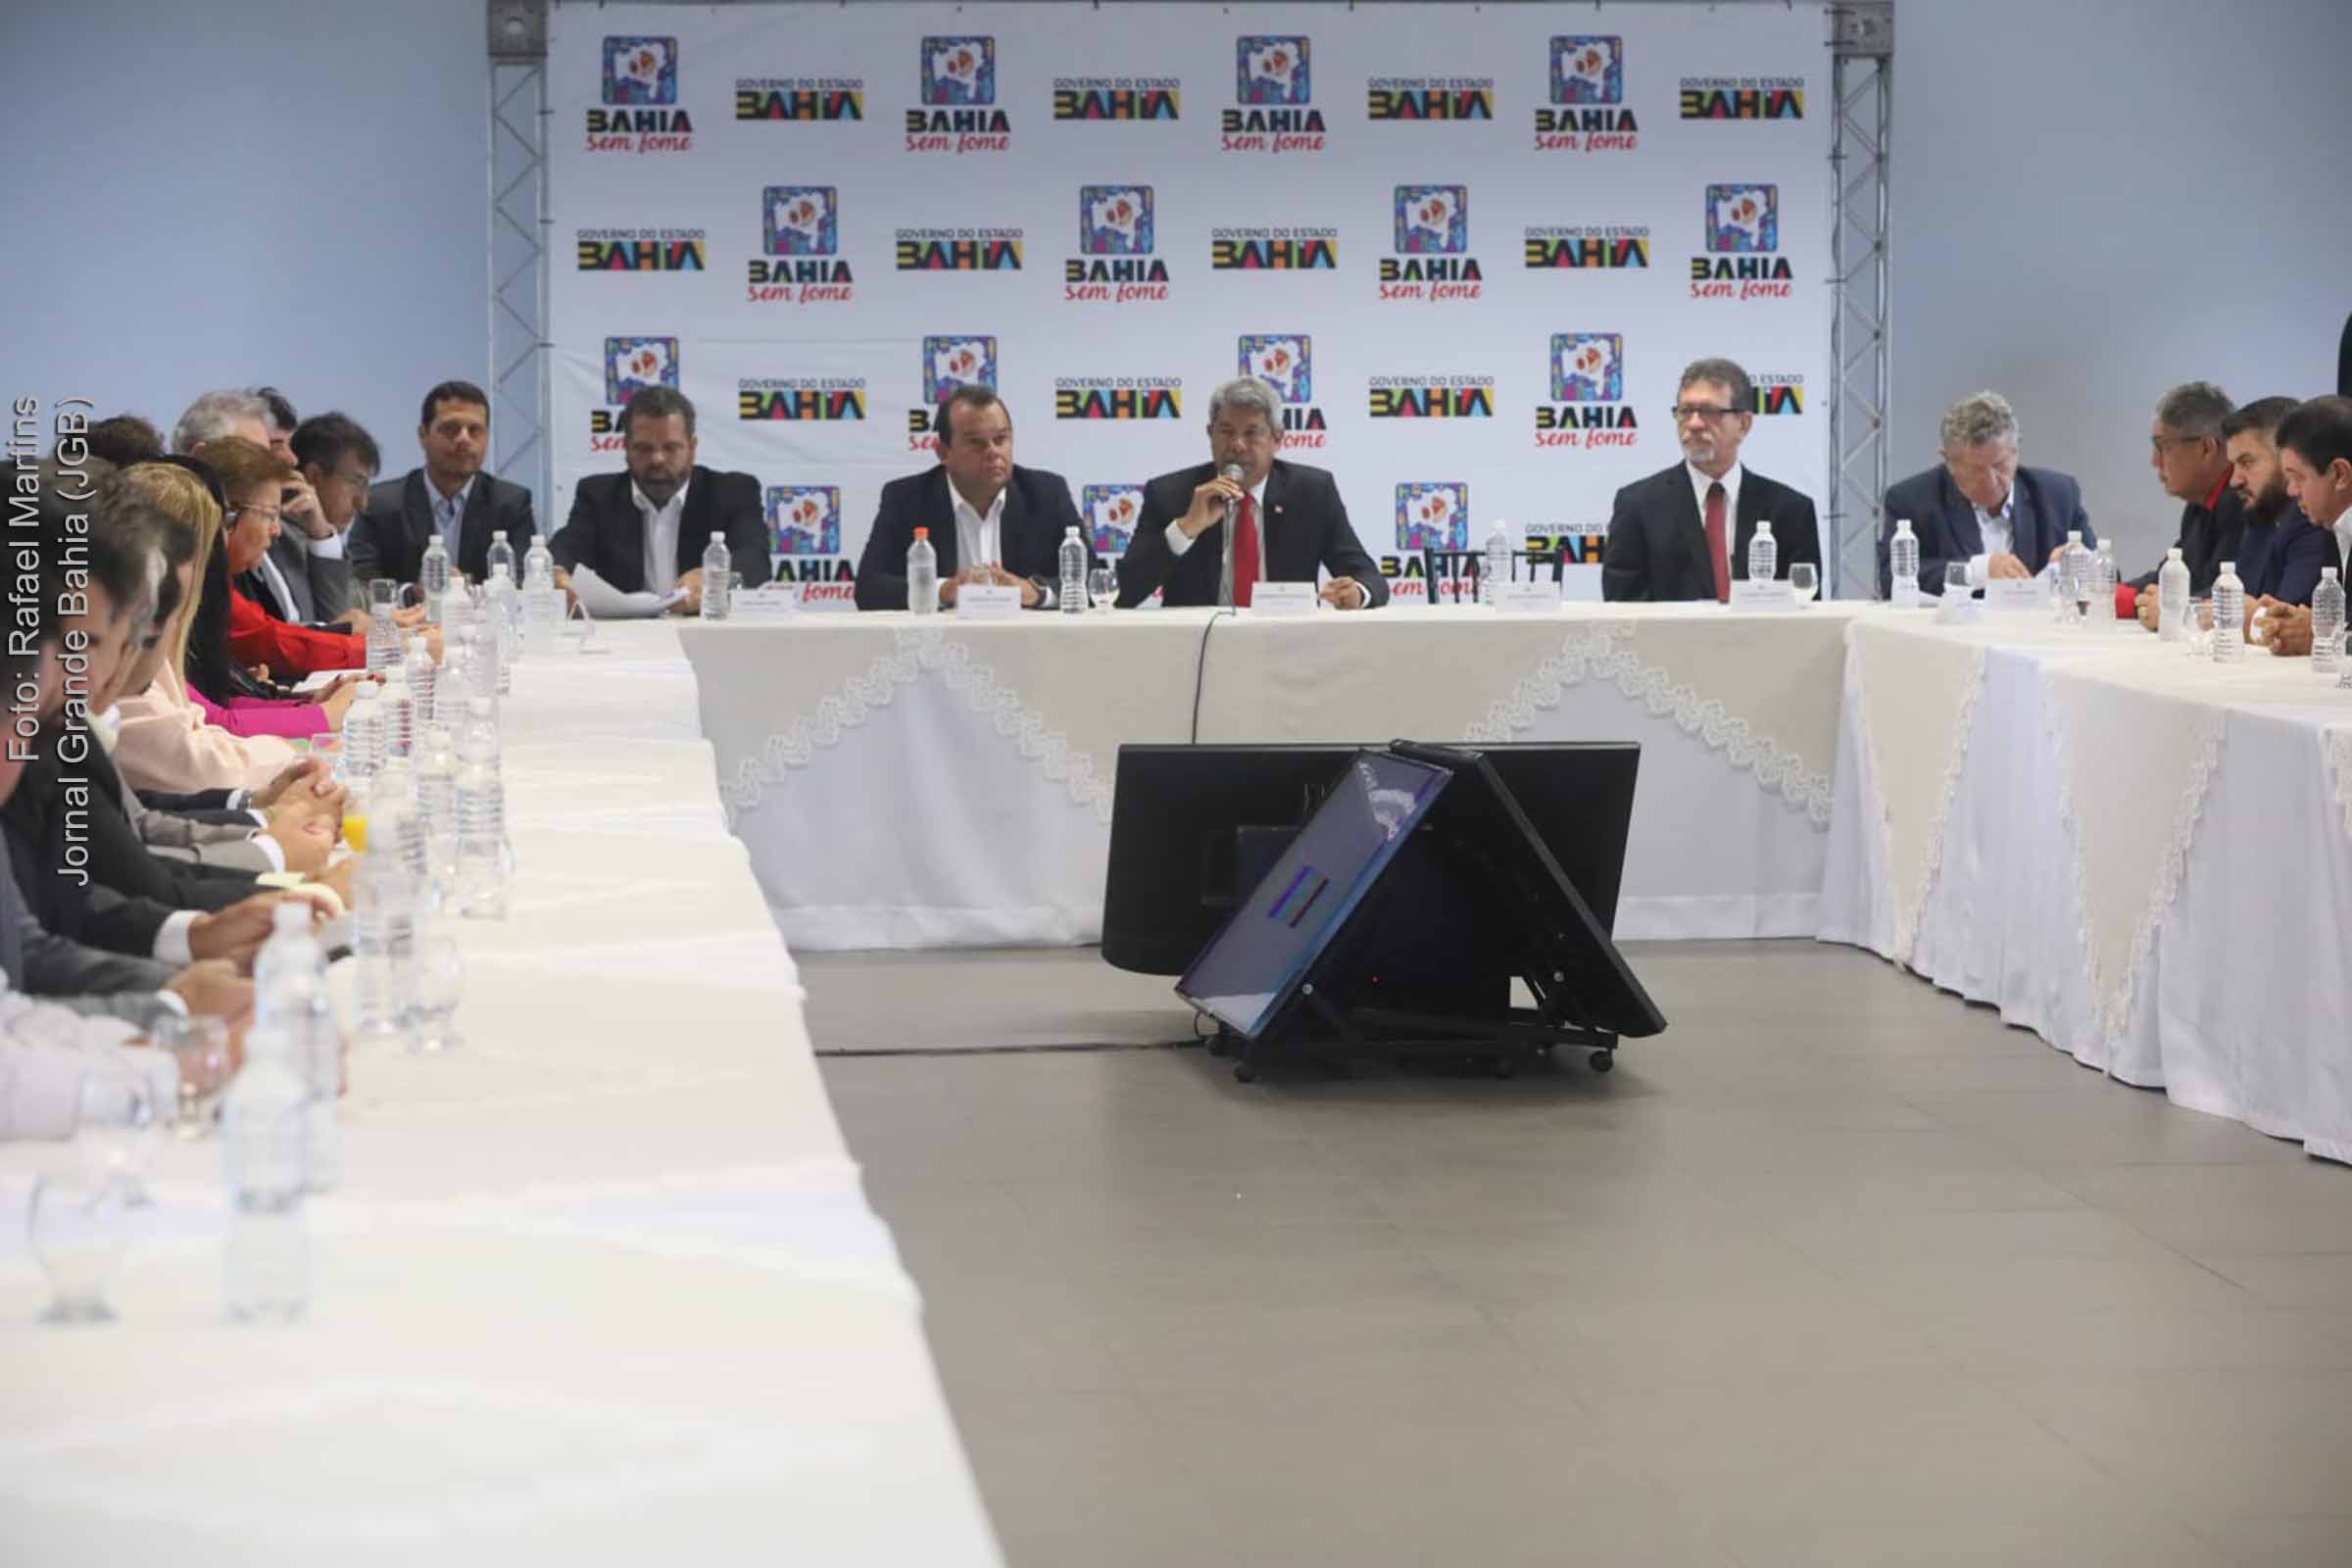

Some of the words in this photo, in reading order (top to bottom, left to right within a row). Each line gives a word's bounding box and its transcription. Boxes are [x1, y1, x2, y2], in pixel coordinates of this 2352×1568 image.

[736, 78, 793, 88] GOVERNO
[799, 78, 814, 88] DO
[817, 78, 862, 88] ESTADO
[1054, 77, 1109, 88] GOVERNO
[1115, 77, 1131, 88] DO
[1135, 77, 1179, 88] ESTADO
[1368, 77, 1424, 88] GOVERNO
[1430, 77, 1446, 88] DO
[1449, 77, 1494, 88] ESTADO
[1681, 77, 1736, 88] GOVERNO
[1741, 77, 1757, 88] DO
[1760, 77, 1804, 88] ESTADO
[586, 109, 692, 132] BAHIA
[906, 109, 1010, 132] BAHIA
[1221, 109, 1326, 132] BAHIA
[1535, 109, 1638, 131] BAHIA
[577, 228, 635, 238] GOVERNO
[641, 228, 657, 238] DO
[660, 228, 706, 238] ESTADO
[897, 227, 953, 238] GOVERNO
[958, 227, 974, 238] DO
[978, 227, 1022, 238] ESTADO
[1212, 227, 1268, 238] GOVERNO
[1274, 227, 1289, 238] DO
[1293, 227, 1337, 238] ESTADO
[1526, 226, 1581, 237] GOVERNO
[1587, 226, 1602, 237] DO
[1605, 226, 1649, 237] ESTADO
[748, 260, 853, 283] BAHIA
[1064, 259, 1169, 282] BAHIA
[1379, 258, 1483, 280] BAHIA
[1690, 257, 1792, 279] BAHIA
[739, 378, 796, 388] GOVERNO
[802, 378, 817, 388] DO
[821, 378, 866, 388] ESTADO
[1055, 376, 1111, 387] GOVERNO
[1117, 376, 1133, 387] DO
[1137, 376, 1181, 387] ESTADO
[1369, 375, 1425, 386] GOVERNO
[1431, 375, 1446, 386] DO
[1449, 375, 1494, 386] ESTADO
[1535, 406, 1638, 428] BAHIA
[1525, 522, 1584, 533] GOVERNO
[775, 559, 857, 582] AHIA
